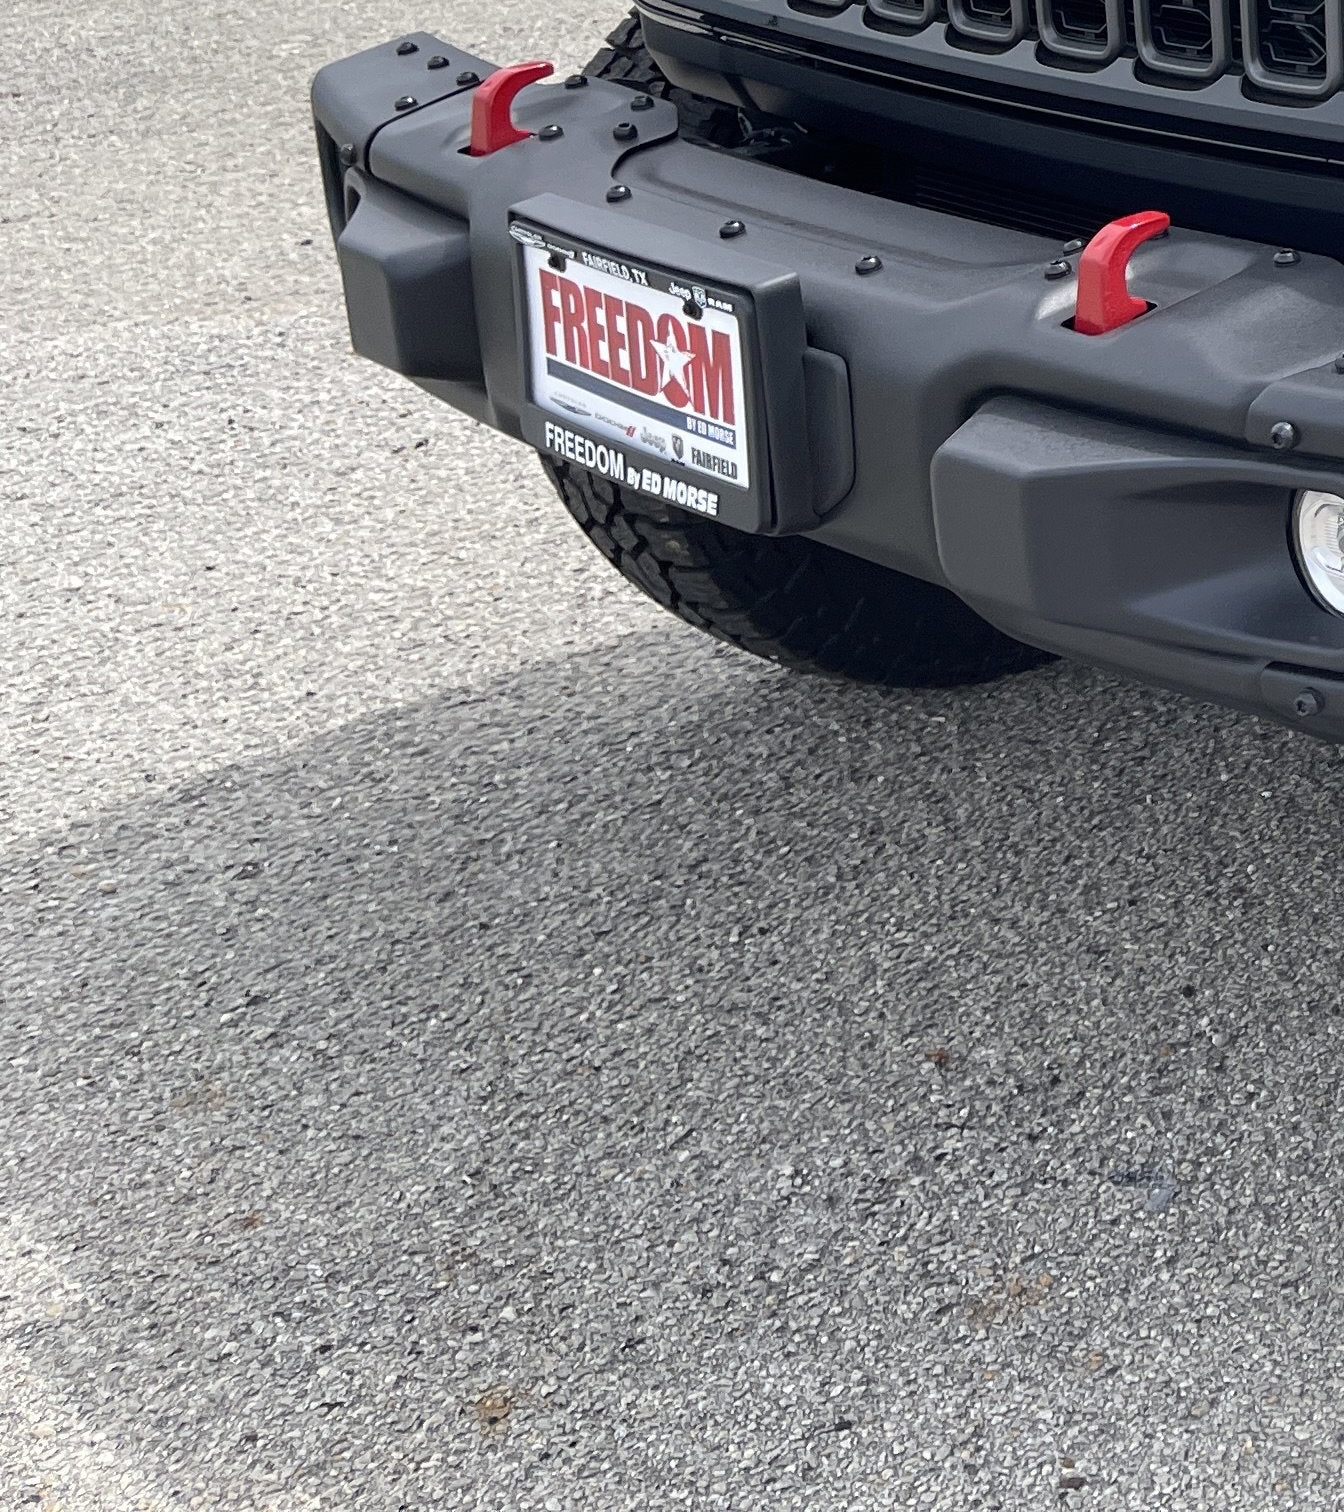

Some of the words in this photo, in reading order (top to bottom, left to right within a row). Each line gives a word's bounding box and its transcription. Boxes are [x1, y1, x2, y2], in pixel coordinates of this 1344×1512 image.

[632, 268, 648, 286] TX
[668, 282, 692, 301] Jeep
[539, 269, 735, 426] FREEDOM
[697, 420, 707, 436] ED
[707, 424, 734, 446] MORSE
[545, 421, 625, 482] FREEDOM
[642, 468, 661, 496] ED
[663, 476, 719, 517] MORSE
[691, 446, 738, 481] FAIRFIELD
